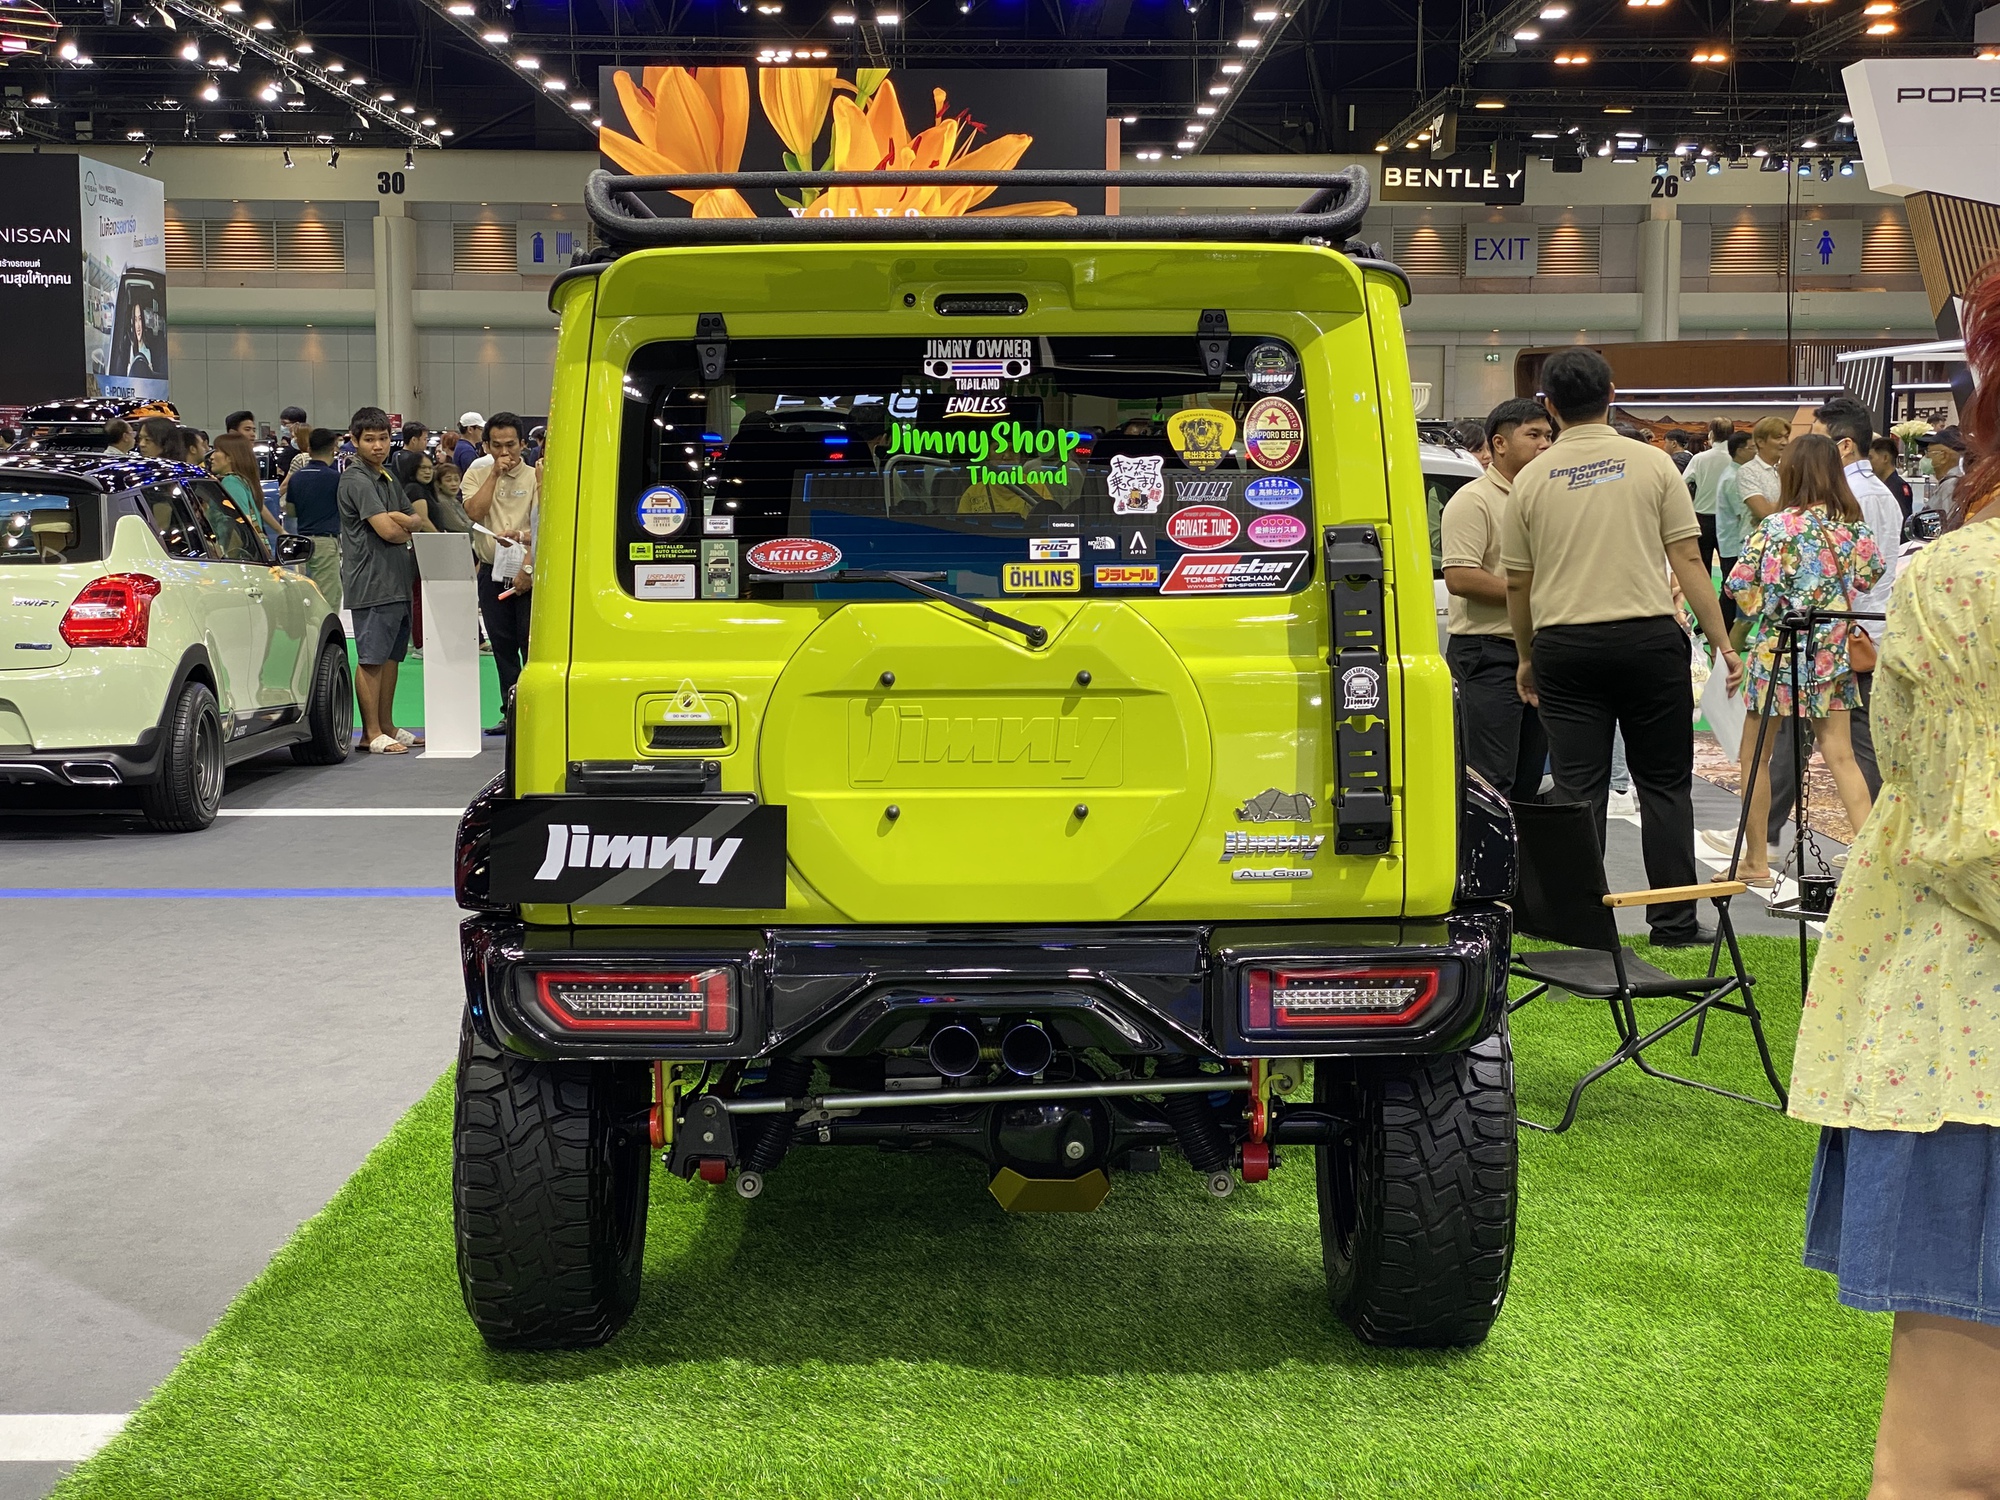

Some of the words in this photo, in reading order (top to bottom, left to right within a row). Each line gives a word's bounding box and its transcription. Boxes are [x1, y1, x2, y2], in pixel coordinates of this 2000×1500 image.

[377, 171, 405, 195] 30
[1385, 167, 1522, 188] BENTLEY
[1651, 175, 1679, 198] 26
[0, 228, 71, 244] NISSAN
[1474, 238, 1530, 261] EXIT
[922, 339, 972, 358] JIMNY
[976, 339, 1032, 358] OWNER
[955, 378, 1001, 391] THAILAND
[945, 397, 1008, 413] ENDLESS
[1901, 406, 1949, 418] PRSCHE
[1249, 430, 1280, 440] SAPPORO
[1280, 430, 1299, 439] BEER
[1549, 458, 1614, 479] Empower
[1568, 463, 1626, 486] Journey
[1175, 519, 1208, 537] PRIVATE
[1211, 518, 1232, 536] TUNE
[1031, 543, 1078, 551] TRUST
[1010, 567, 1074, 586] ÖHLINS
[1097, 568, 1156, 582] プラレール
[1181, 559, 1293, 575] monster
[1184, 575, 1281, 583] TOMEI-YOKOHAMA
[1345, 697, 1378, 708] Jimny
[853, 705, 1117, 783] Jimny
[534, 824, 743, 884] Jimny
[1220, 831, 1325, 862] Jimny
